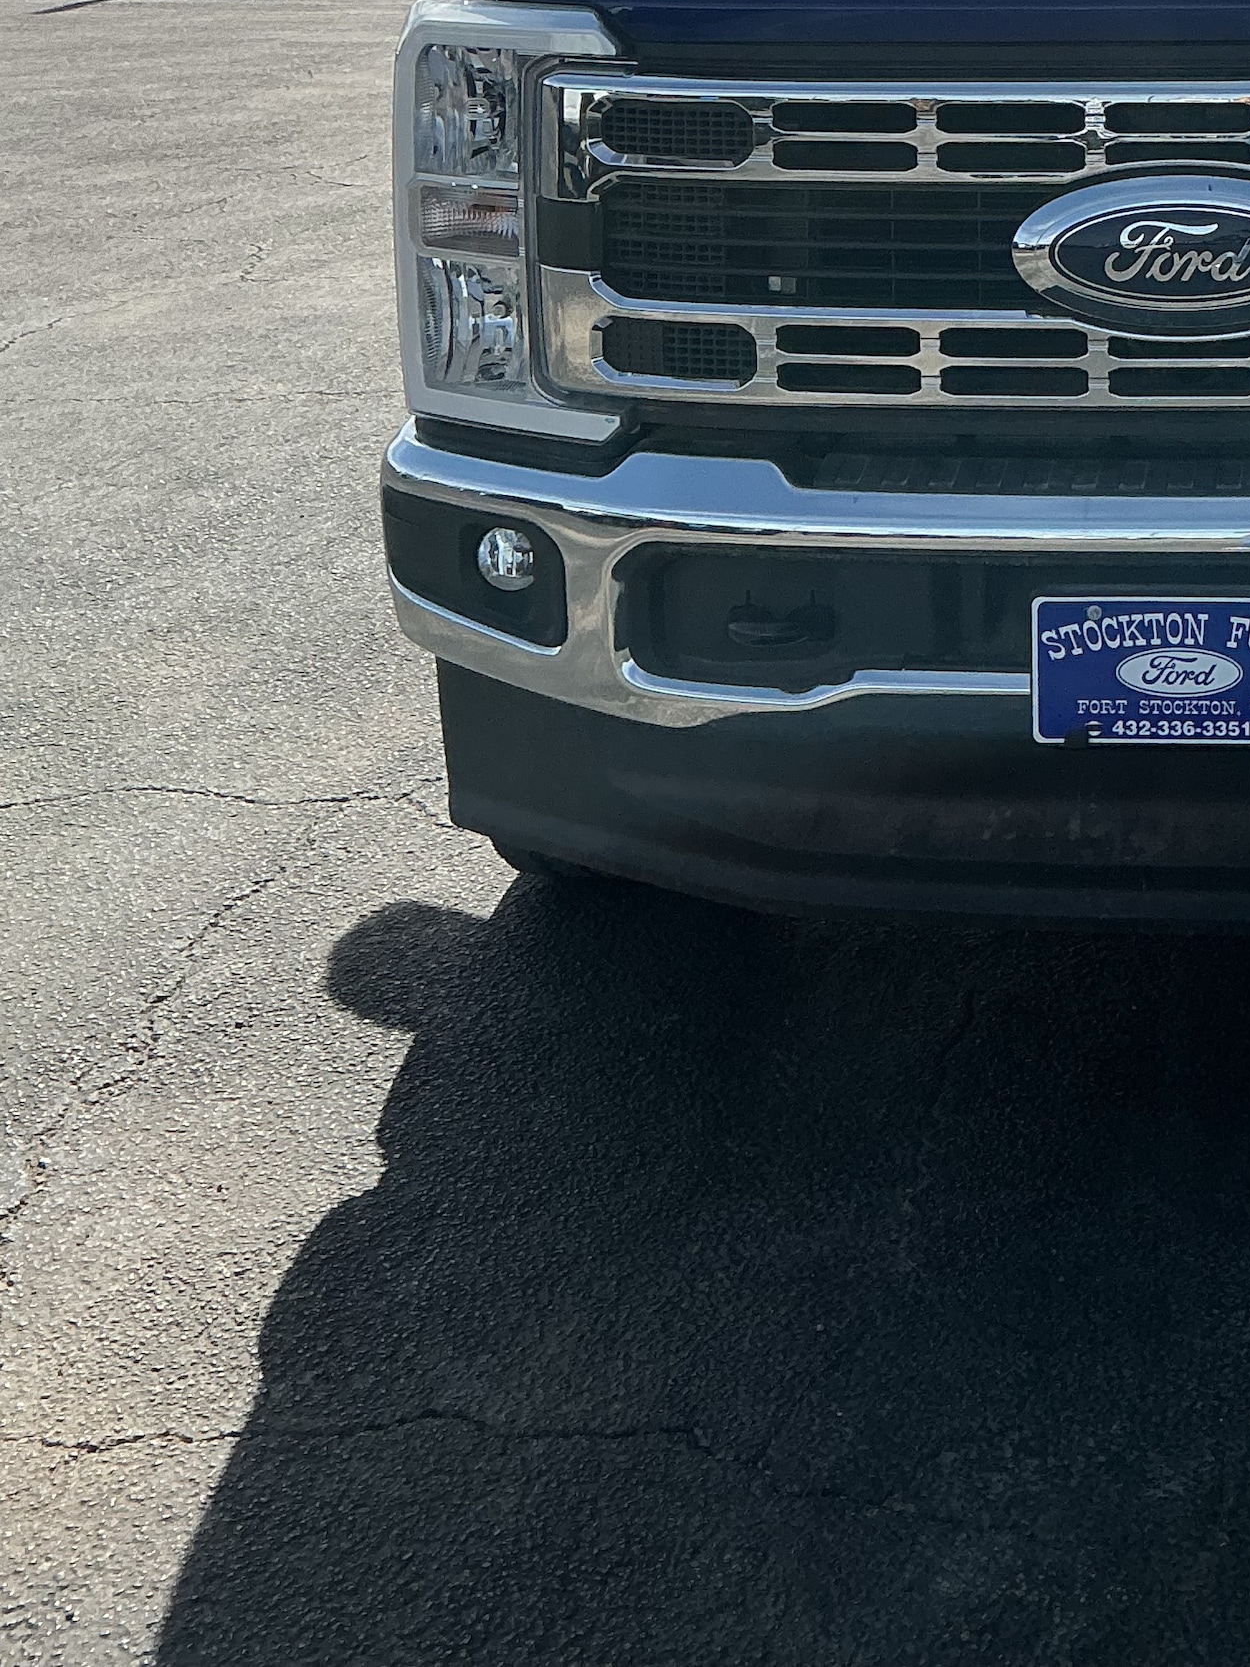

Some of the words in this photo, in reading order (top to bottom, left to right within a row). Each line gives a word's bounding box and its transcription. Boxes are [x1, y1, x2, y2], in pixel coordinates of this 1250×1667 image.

[1041, 612, 1208, 661] STOCKTON
[1141, 655, 1217, 686] Ford
[1077, 700, 1127, 714] FORT
[1112, 721, 1250, 736] 432-336-3351
